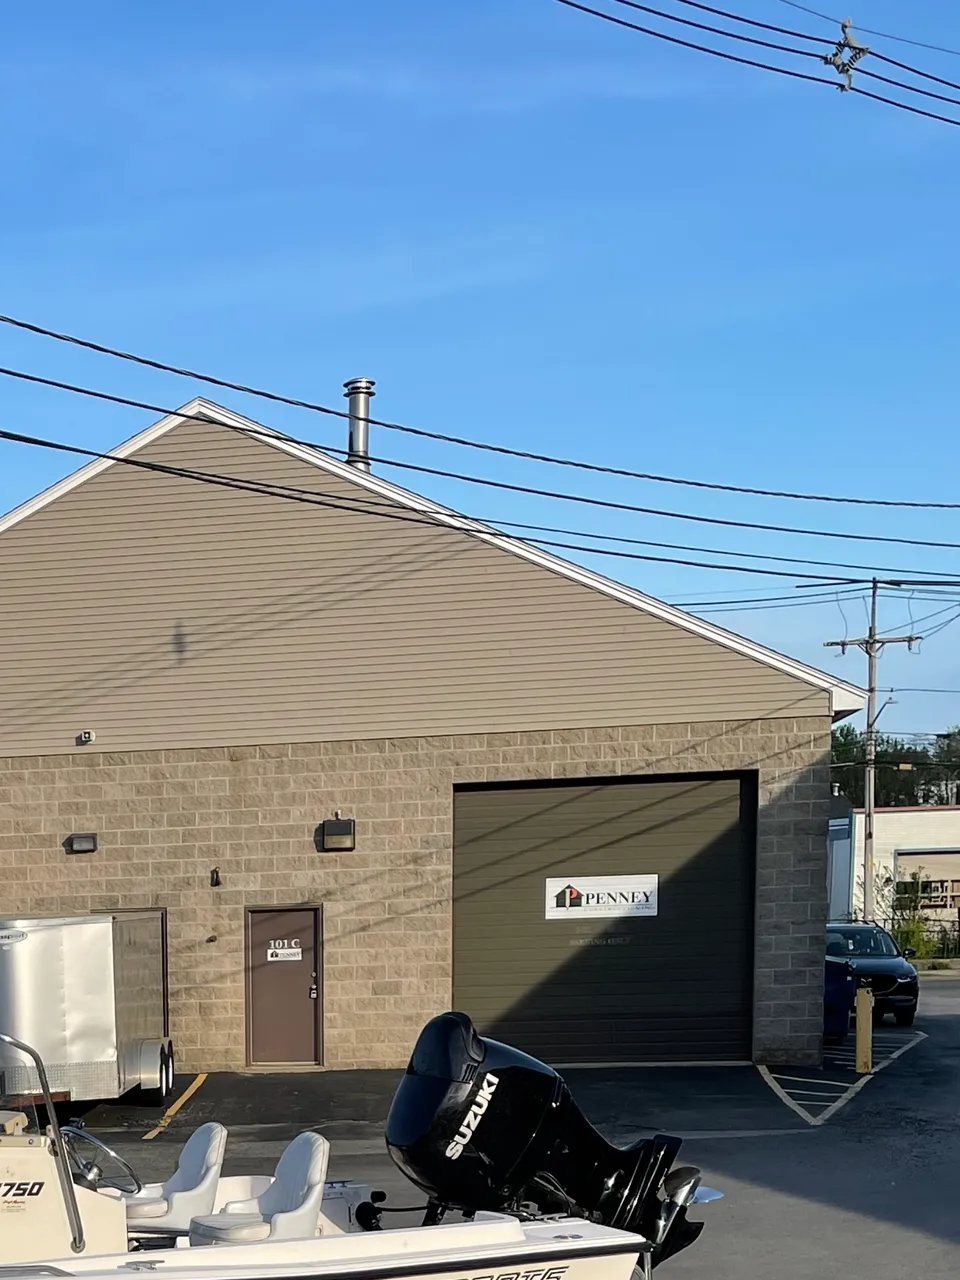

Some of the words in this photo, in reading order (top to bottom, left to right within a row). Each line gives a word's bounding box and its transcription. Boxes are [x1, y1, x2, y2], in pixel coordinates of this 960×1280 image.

[585, 890, 654, 905] PENNEY
[269, 939, 288, 949] 101
[291, 938, 300, 948] C
[445, 1072, 500, 1160] SUZUKI
